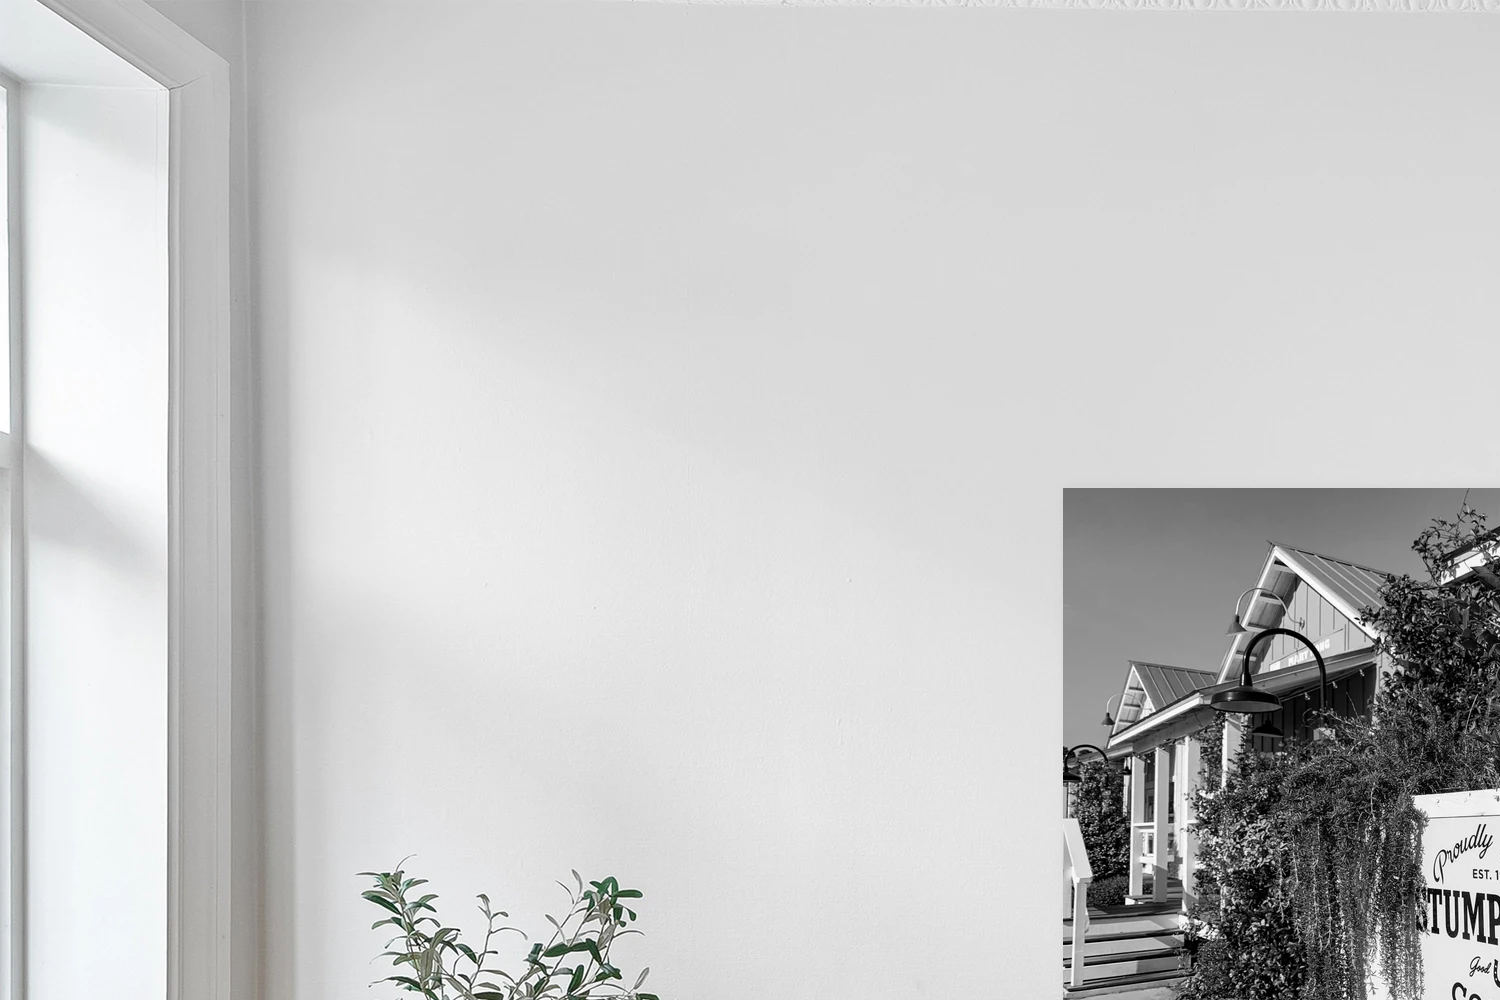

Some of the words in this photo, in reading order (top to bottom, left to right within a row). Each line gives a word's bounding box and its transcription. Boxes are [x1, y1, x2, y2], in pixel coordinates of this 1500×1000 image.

[1432, 823, 1494, 885] Proudly
[1472, 868, 1493, 880] EST.
[1468, 955, 1492, 978] Good
